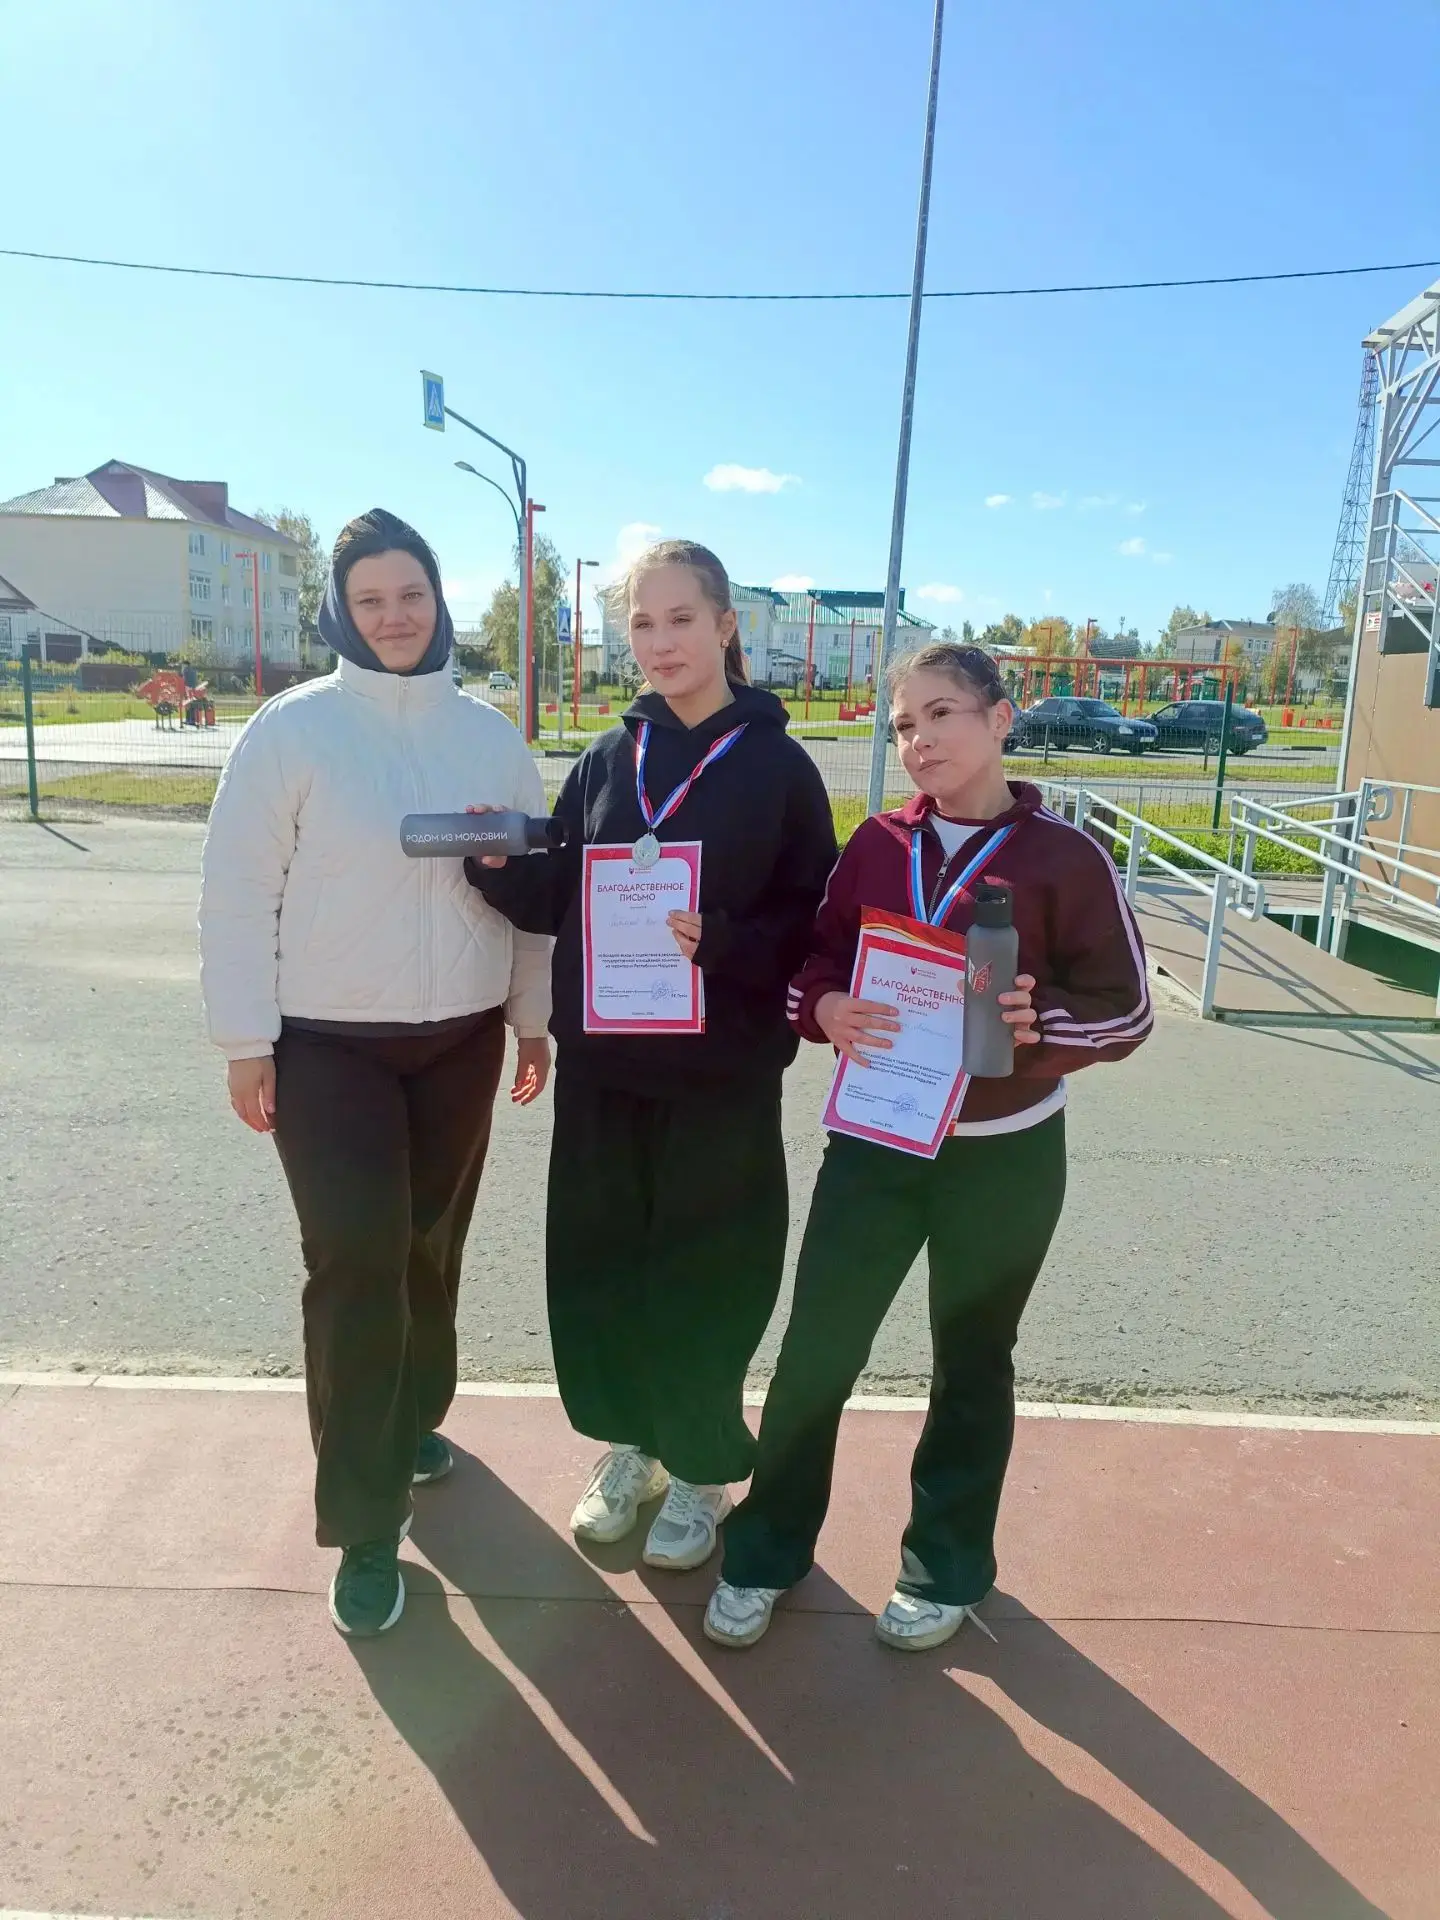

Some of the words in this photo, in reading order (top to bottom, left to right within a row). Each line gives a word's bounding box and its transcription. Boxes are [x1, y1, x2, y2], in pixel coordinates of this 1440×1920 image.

[406, 834, 439, 843] РОДОМ
[441, 833, 453, 842] ИЗ
[455, 832, 507, 842] МОРДОВИИ
[597, 882, 685, 893] БЛАГОДАРСТВЕННОЕ
[619, 893, 656, 902] ПИСЬМО
[871, 976, 965, 1006] БЛАГОДАРСТВЕННО
[896, 992, 940, 1010] ПИСЬМО
